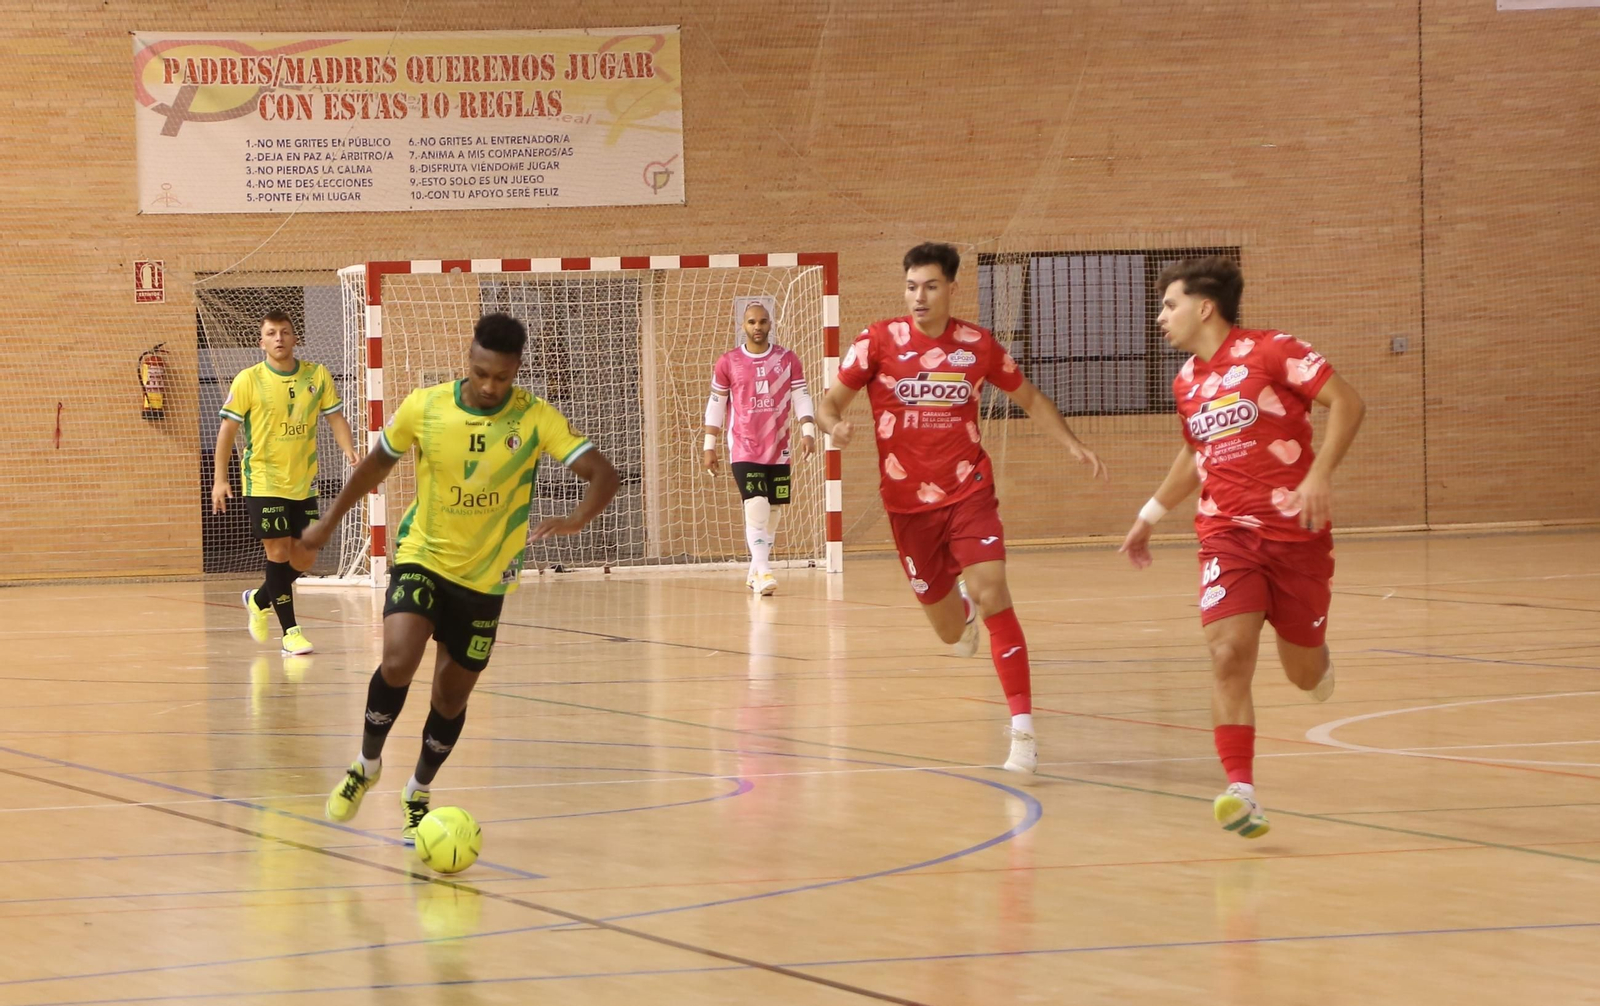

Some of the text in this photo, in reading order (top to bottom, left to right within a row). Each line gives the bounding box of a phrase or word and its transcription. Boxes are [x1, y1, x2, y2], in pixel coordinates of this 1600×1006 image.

[163, 51, 655, 87] PADRES/MADRES QUEREMOS JUGAR
[258, 93, 314, 121] CON
[323, 91, 408, 120] ESTAS
[420, 91, 450, 119] 10
[459, 89, 563, 118] REGLAS
[245, 136, 391, 148] 1.-NO ME GRITES EN PÚBLICO
[408, 134, 570, 147] 6.-NO GRITES AL ENTRENADOR/A
[245, 152, 283, 162] 2.-DEJA
[286, 152, 301, 161] EN
[303, 152, 323, 161] PAZ
[325, 152, 338, 161] AL
[408, 150, 455, 160] 7.-ANIMA
[457, 150, 465, 159] A
[467, 149, 485, 159] MIS
[245, 164, 373, 175] 3.-NO PIERDAS LA CALMA
[409, 163, 468, 173] 8.-DISFRUTA
[526, 161, 560, 171] JUGAR
[246, 178, 374, 189] 4.-NO ME DES LECCIONES
[449, 176, 476, 186] SOLO
[479, 176, 491, 185] ES
[493, 175, 508, 185] UN
[510, 174, 545, 184] JUEGO
[246, 191, 361, 202] 5.-PONTE EN MI LUGAR
[410, 190, 450, 200] 10.-CON
[452, 190, 465, 199] TU
[468, 189, 504, 199] APOYO
[533, 187, 559, 197] FELIZ
[756, 366, 766, 377] 13
[288, 387, 296, 399] 6
[469, 433, 486, 452] 15
[449, 485, 500, 508] Jaén
[905, 556, 917, 576] 8
[473, 640, 488, 653] LZ
